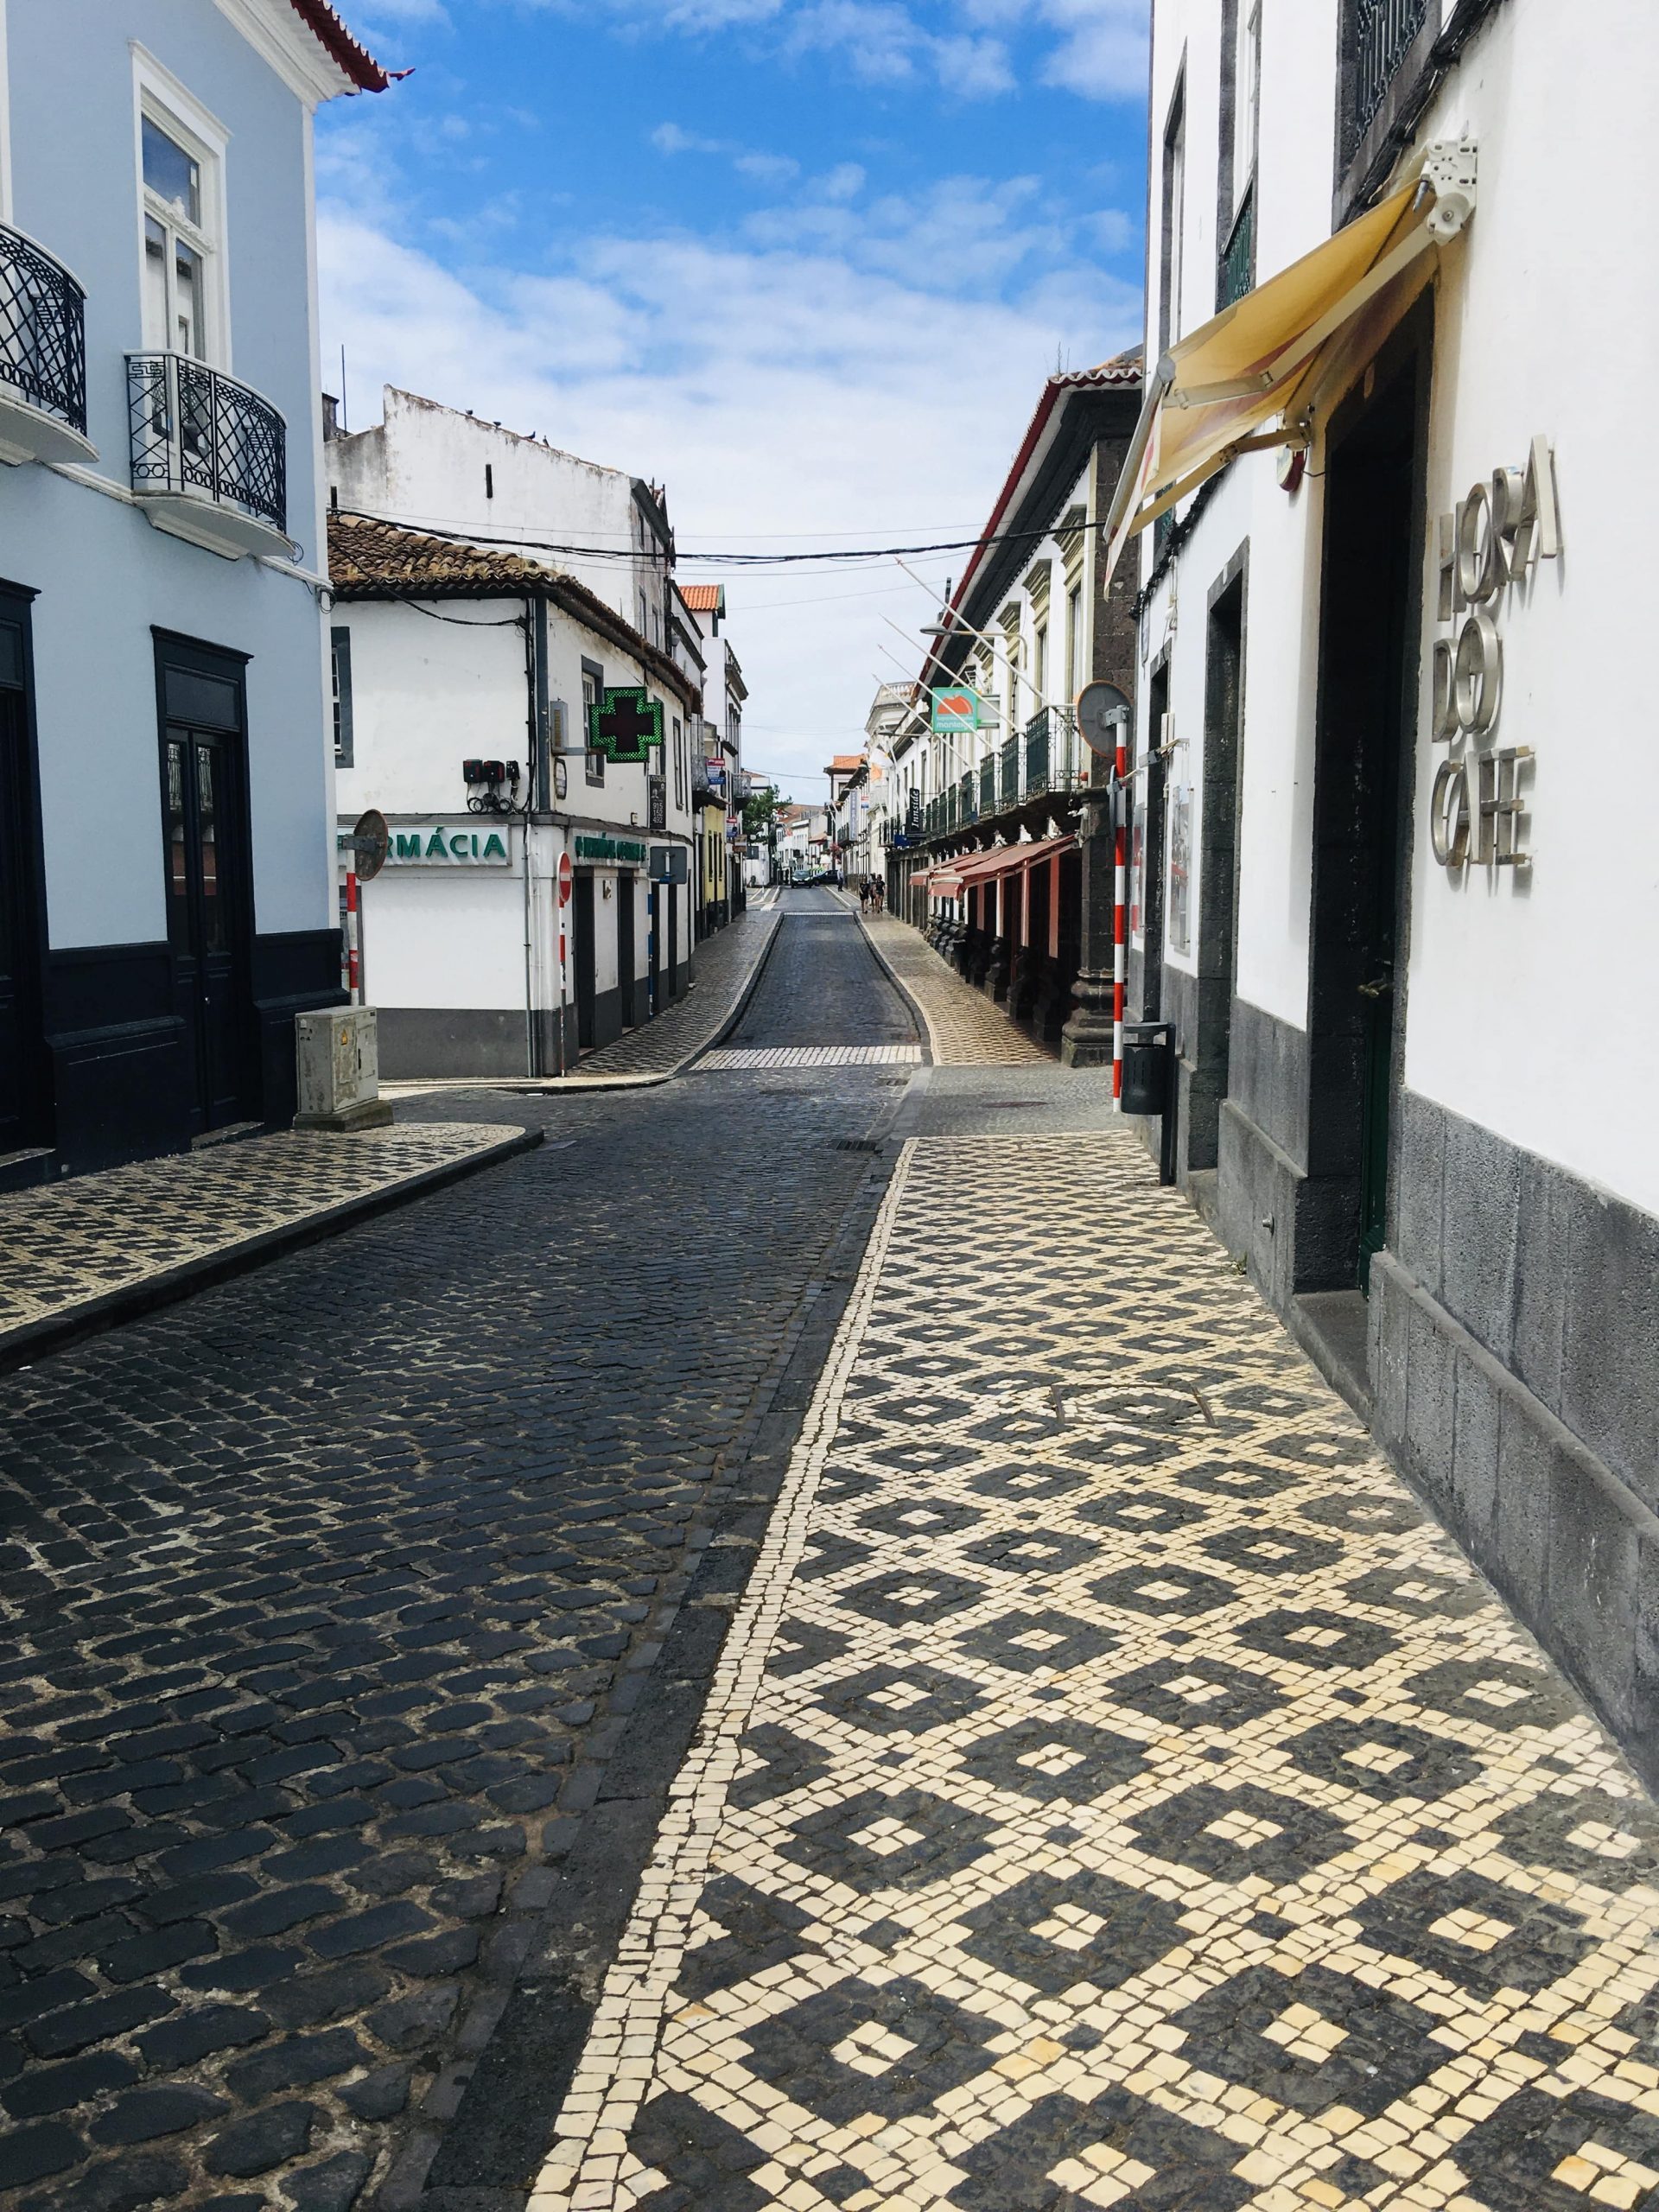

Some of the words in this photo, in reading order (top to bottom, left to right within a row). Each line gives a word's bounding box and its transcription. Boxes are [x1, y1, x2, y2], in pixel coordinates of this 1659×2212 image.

[1437, 434, 1557, 622] HORA
[1432, 614, 1498, 742] DO
[337, 827, 506, 857] MÁCIA
[911, 791, 919, 828] Innside
